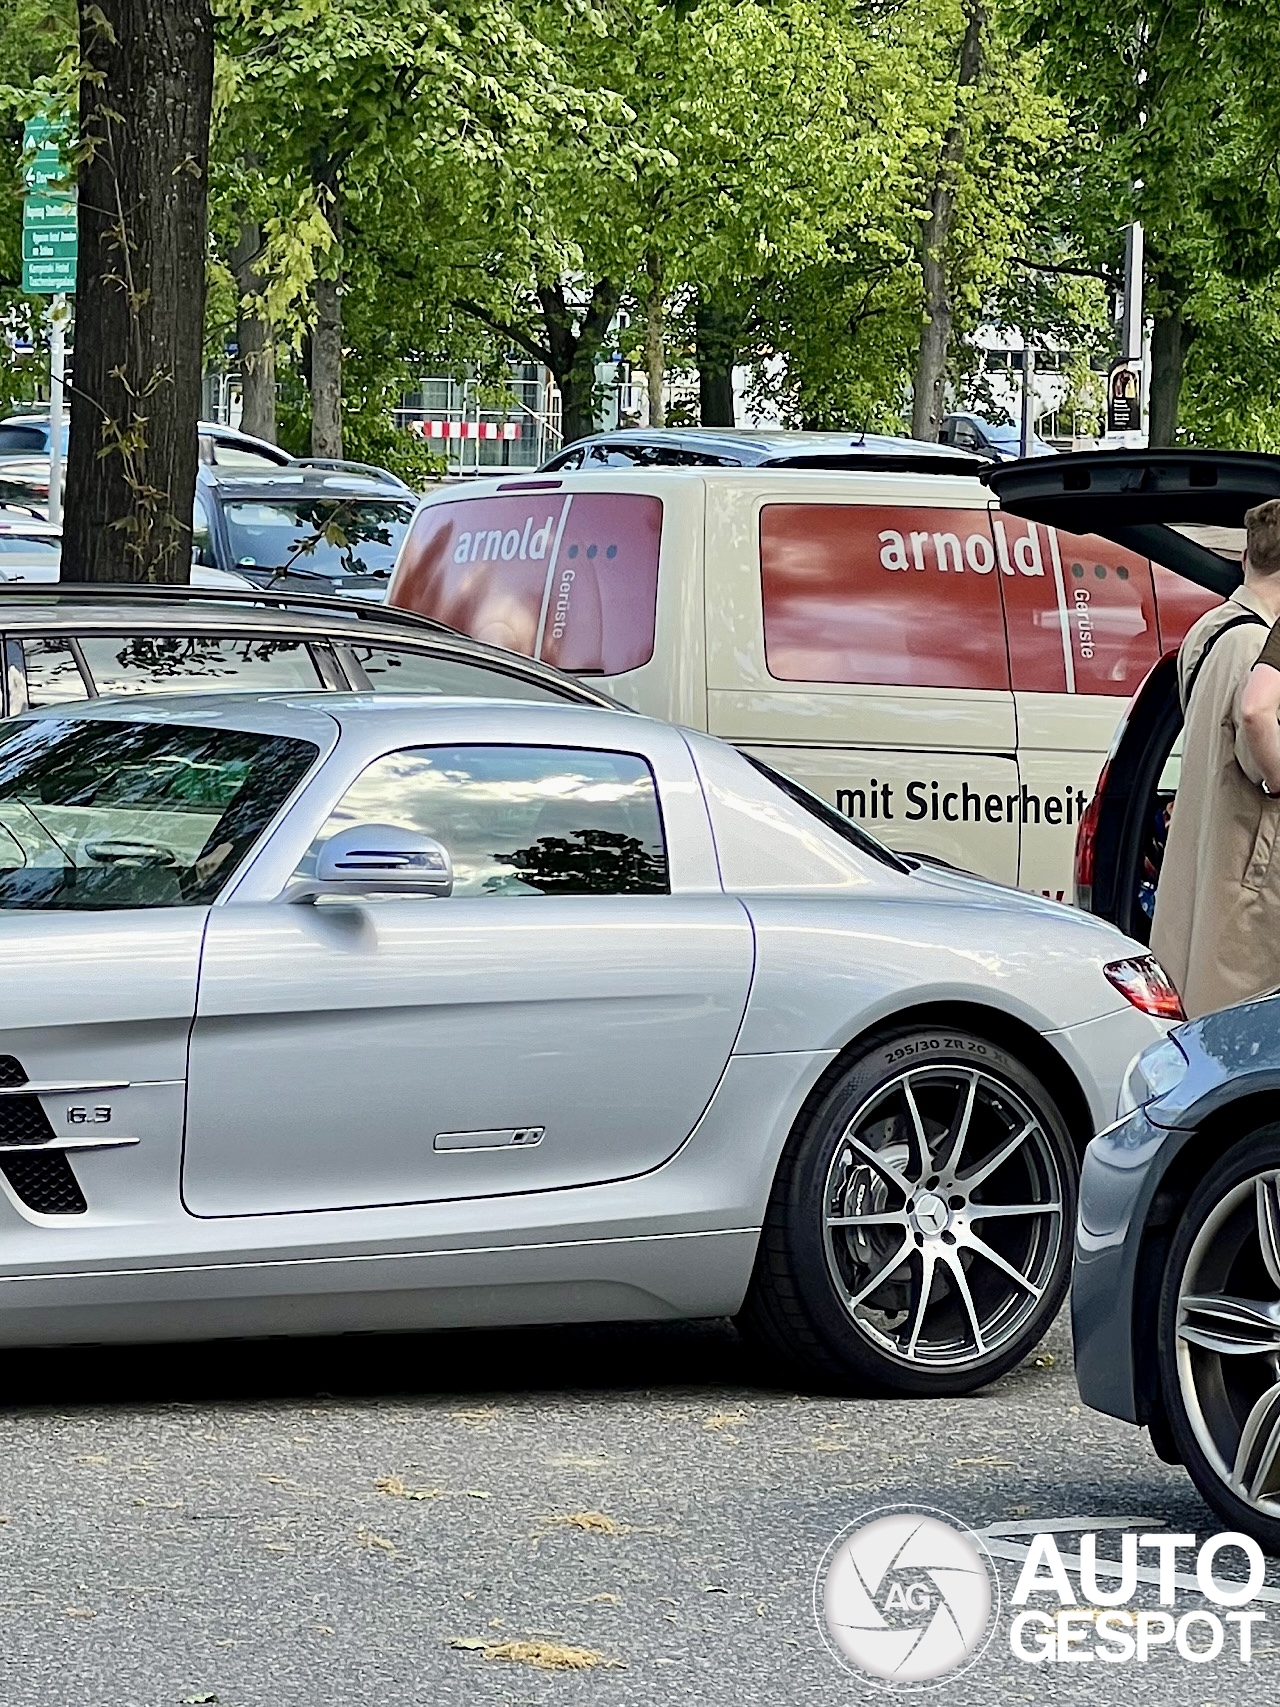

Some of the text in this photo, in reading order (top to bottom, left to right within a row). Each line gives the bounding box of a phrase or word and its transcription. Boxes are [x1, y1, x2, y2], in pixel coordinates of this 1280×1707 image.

[453, 515, 554, 564] arnold
[877, 520, 1046, 577] arnold
[552, 569, 576, 639] Gerüste
[1073, 588, 1094, 659] Gerüste
[836, 778, 1088, 825] mit Sicherheit
[885, 1038, 940, 1064] 295/30
[943, 1038, 965, 1050] ZR
[967, 1041, 987, 1055] 20
[67, 1105, 112, 1123] 6.3
